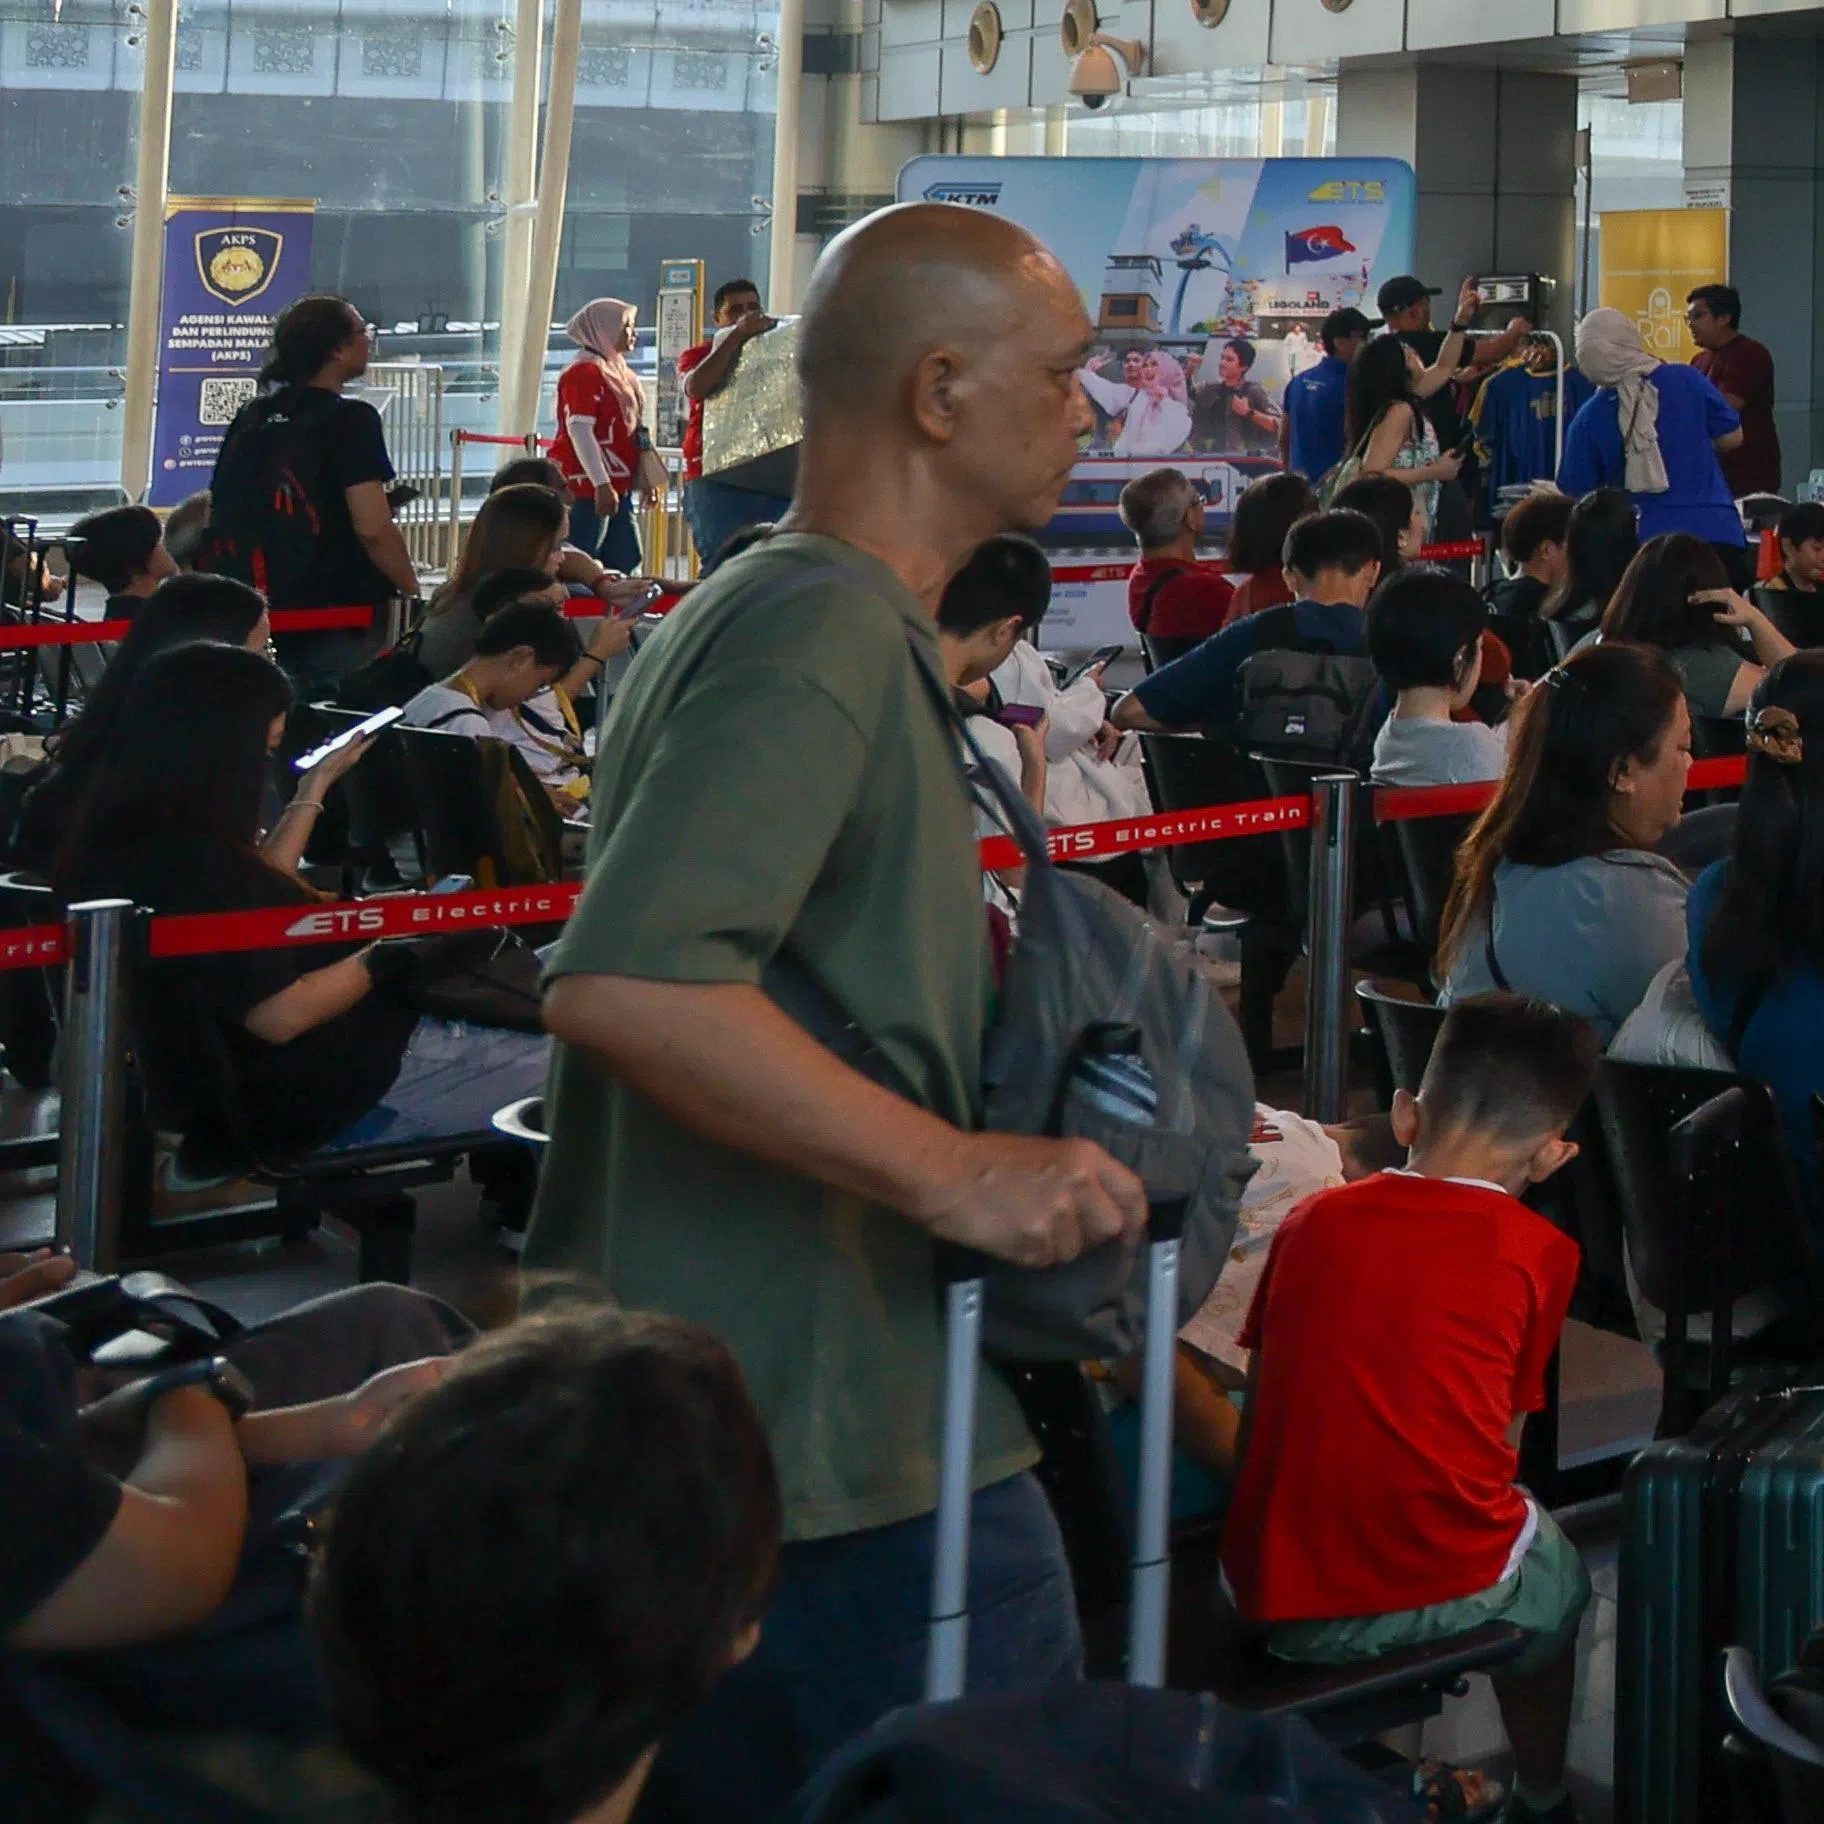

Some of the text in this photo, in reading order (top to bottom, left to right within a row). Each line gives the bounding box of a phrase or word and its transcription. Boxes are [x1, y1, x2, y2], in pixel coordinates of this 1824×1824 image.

[221, 234, 256, 245] AKPS
[180, 315, 224, 325] AGENSI
[172, 327, 198, 337] DAN
[1637, 316, 1681, 348] Rail
[168, 338, 275, 348] SEMPADAN MALA
[211, 351, 252, 362] (AKPS)
[1116, 819, 1223, 843] Electric
[1234, 806, 1301, 826] Train
[310, 907, 385, 935] ETS
[412, 897, 551, 923] Electric
